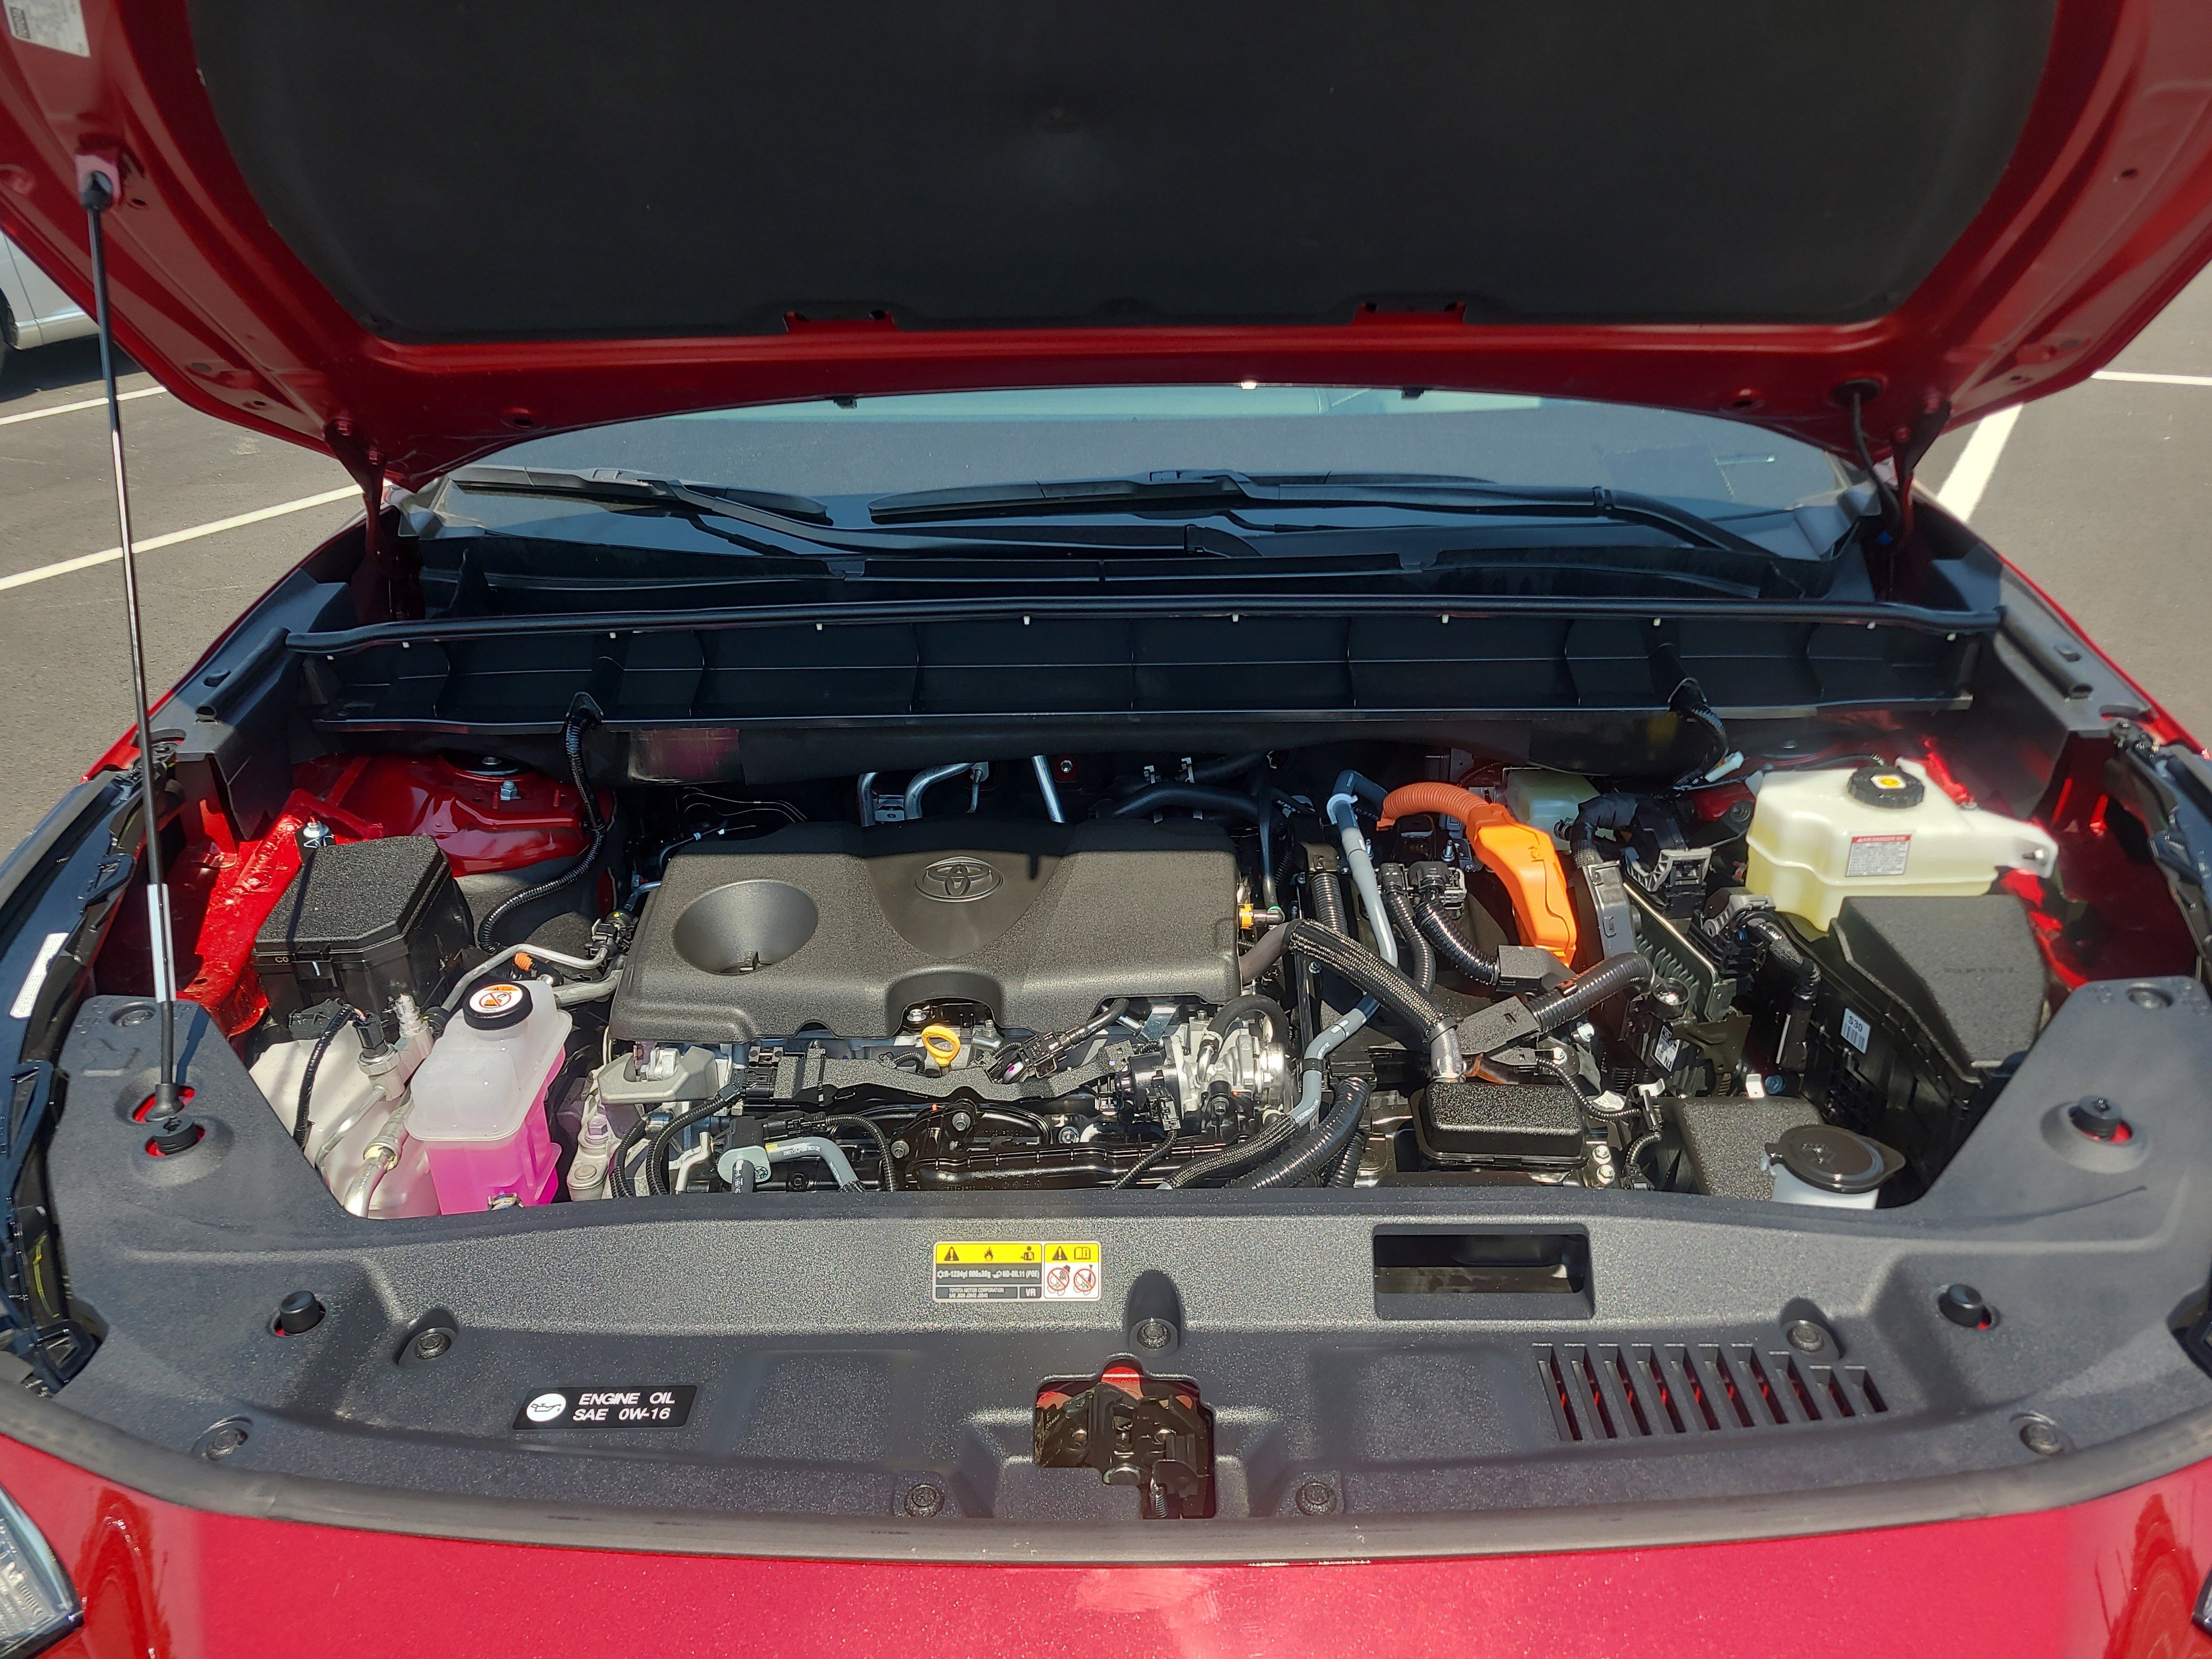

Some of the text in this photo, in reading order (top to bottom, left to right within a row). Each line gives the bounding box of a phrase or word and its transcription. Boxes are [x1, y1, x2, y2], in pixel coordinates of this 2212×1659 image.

[1025, 1288, 1037, 1297] VR
[578, 1391, 675, 1406] ENGINE OIL
[573, 1407, 671, 1421] SAE 0W-16
